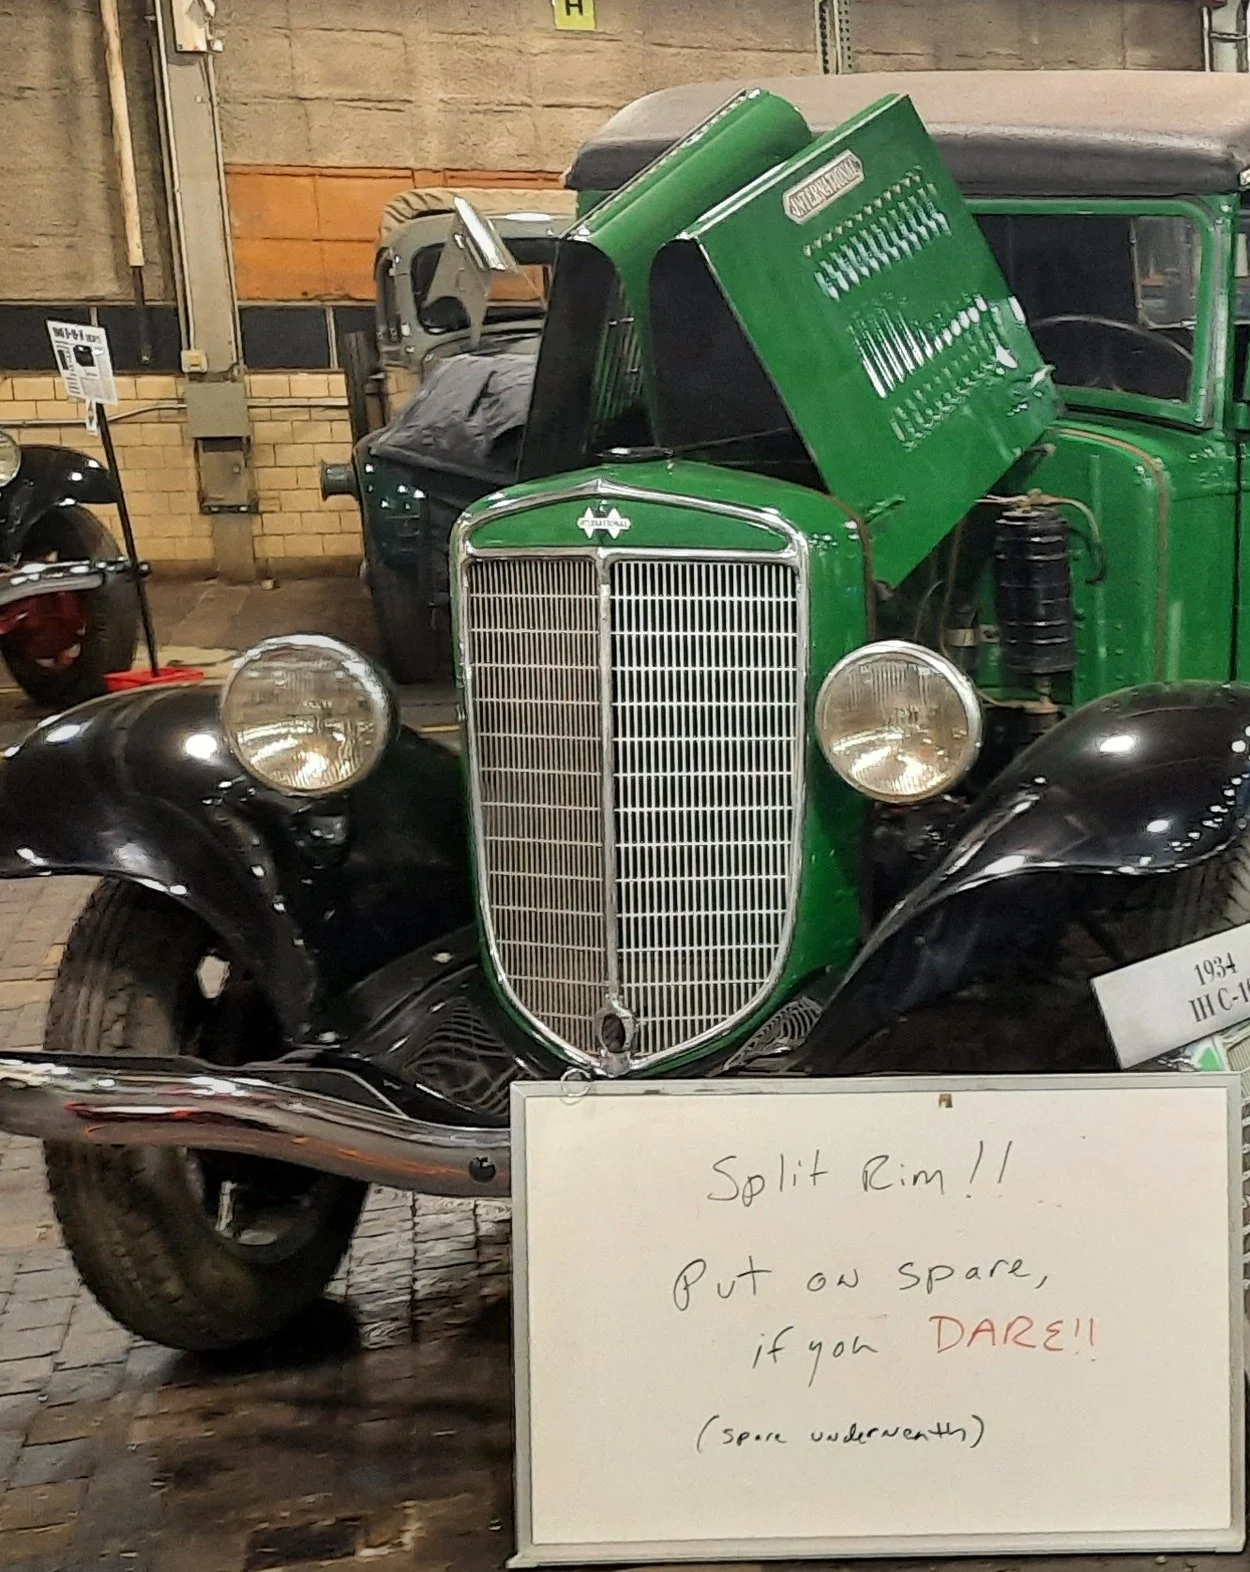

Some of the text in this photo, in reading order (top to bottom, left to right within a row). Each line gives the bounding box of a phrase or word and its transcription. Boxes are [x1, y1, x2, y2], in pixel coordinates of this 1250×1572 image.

[564, 0, 583, 16] H
[1194, 951, 1239, 987] 1934
[707, 1149, 828, 1207] Split
[673, 1255, 772, 1311] Put
[752, 1314, 1099, 1388] if you DARE!!
